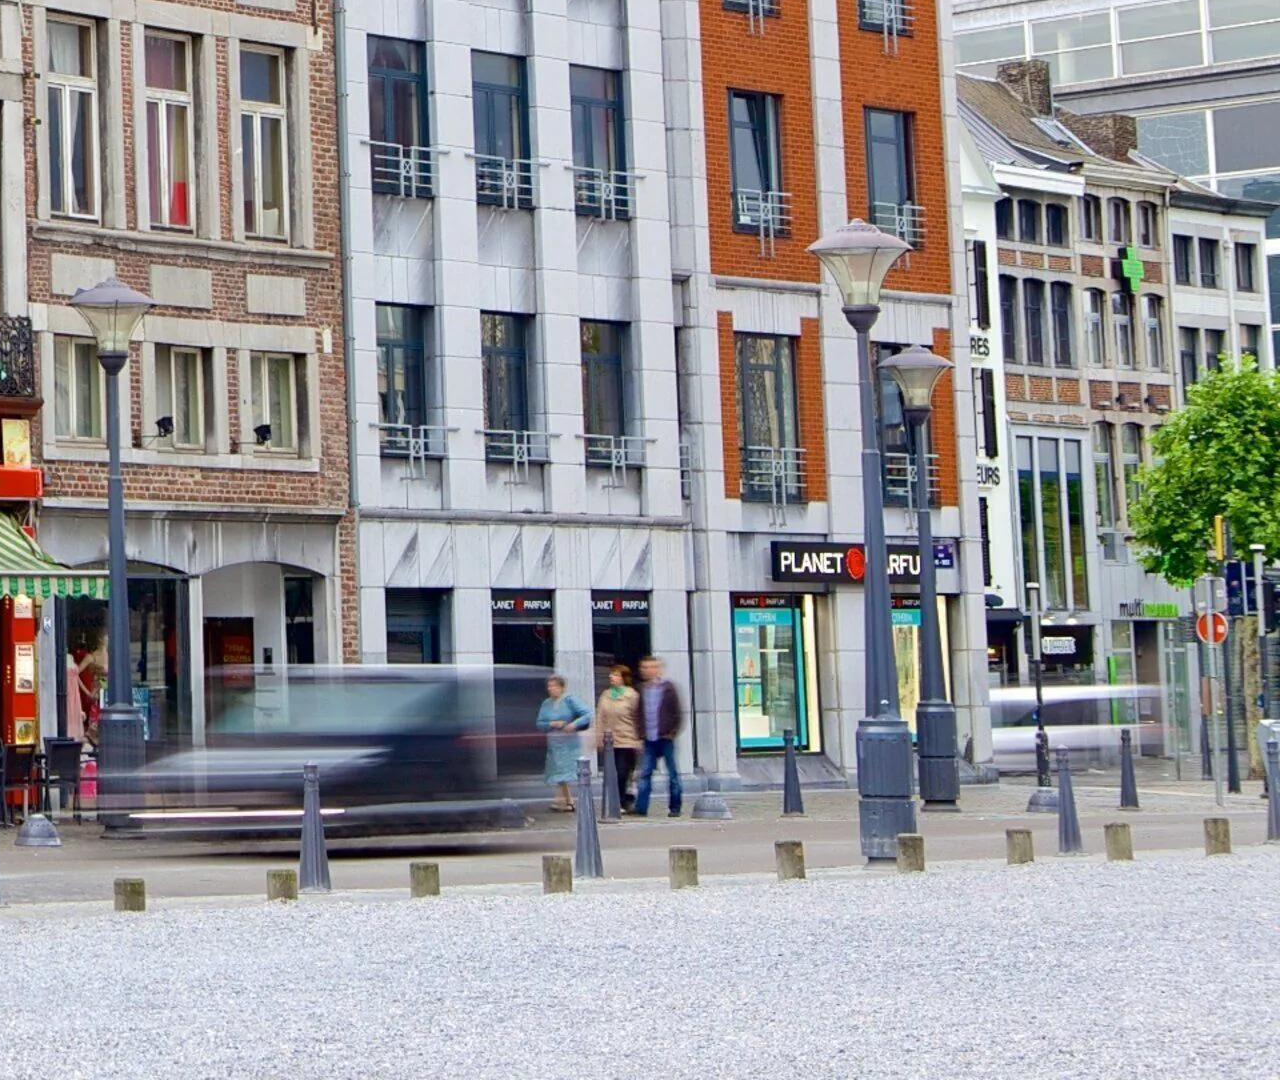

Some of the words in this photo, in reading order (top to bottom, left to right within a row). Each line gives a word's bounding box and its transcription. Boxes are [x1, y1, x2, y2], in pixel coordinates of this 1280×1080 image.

[780, 552, 844, 574] PLANET
[523, 601, 550, 610] PARFUM
[622, 601, 649, 610] PARFUM
[740, 597, 759, 606] PLANET
